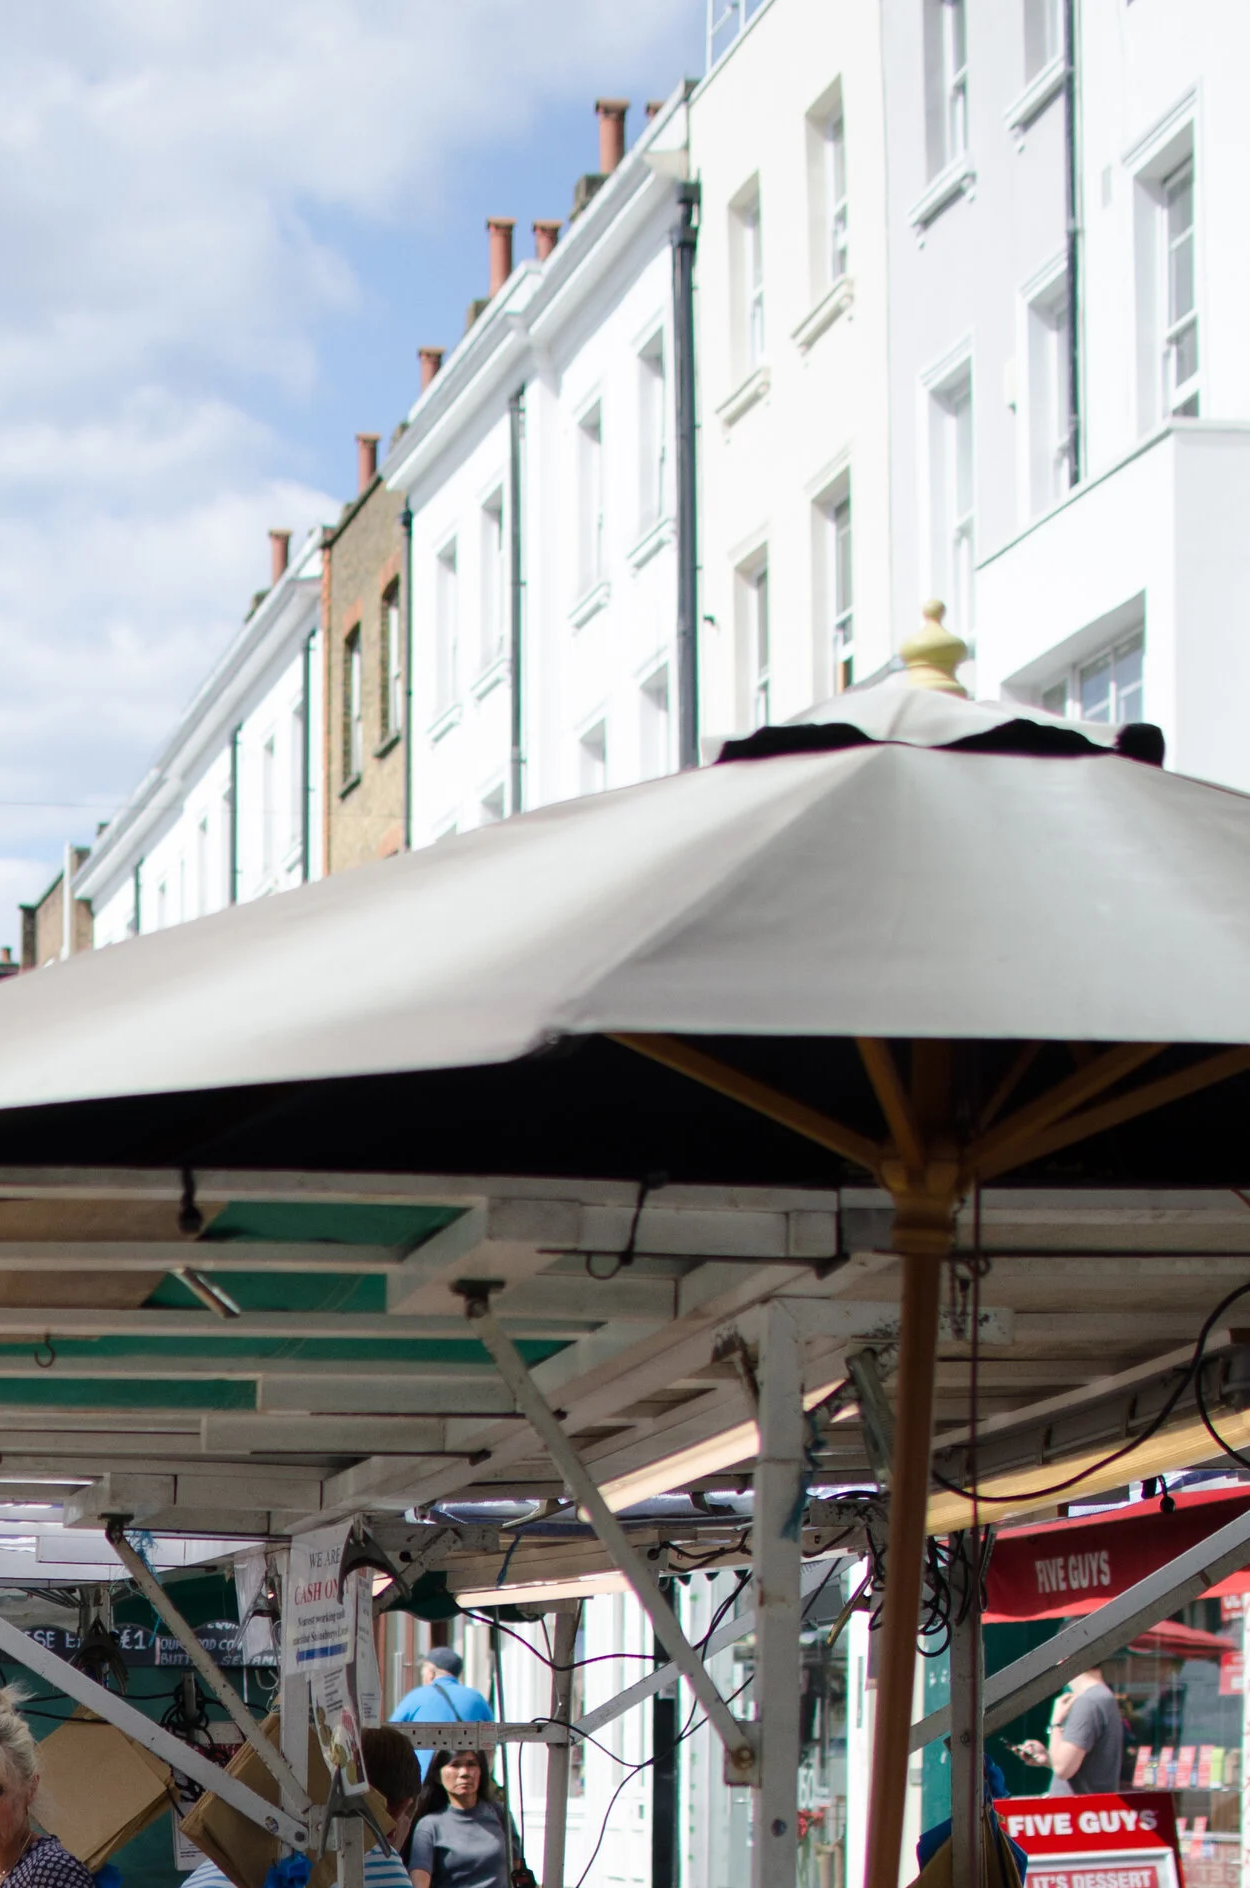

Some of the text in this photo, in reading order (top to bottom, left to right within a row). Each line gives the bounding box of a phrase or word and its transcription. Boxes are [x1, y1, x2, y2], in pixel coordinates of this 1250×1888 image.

[309, 1552, 322, 1568] WE
[1035, 1551, 1111, 1594] FIVE GUYS
[294, 1582, 322, 1606] CASH
[1007, 1809, 1158, 1838] FIVE GUYS
